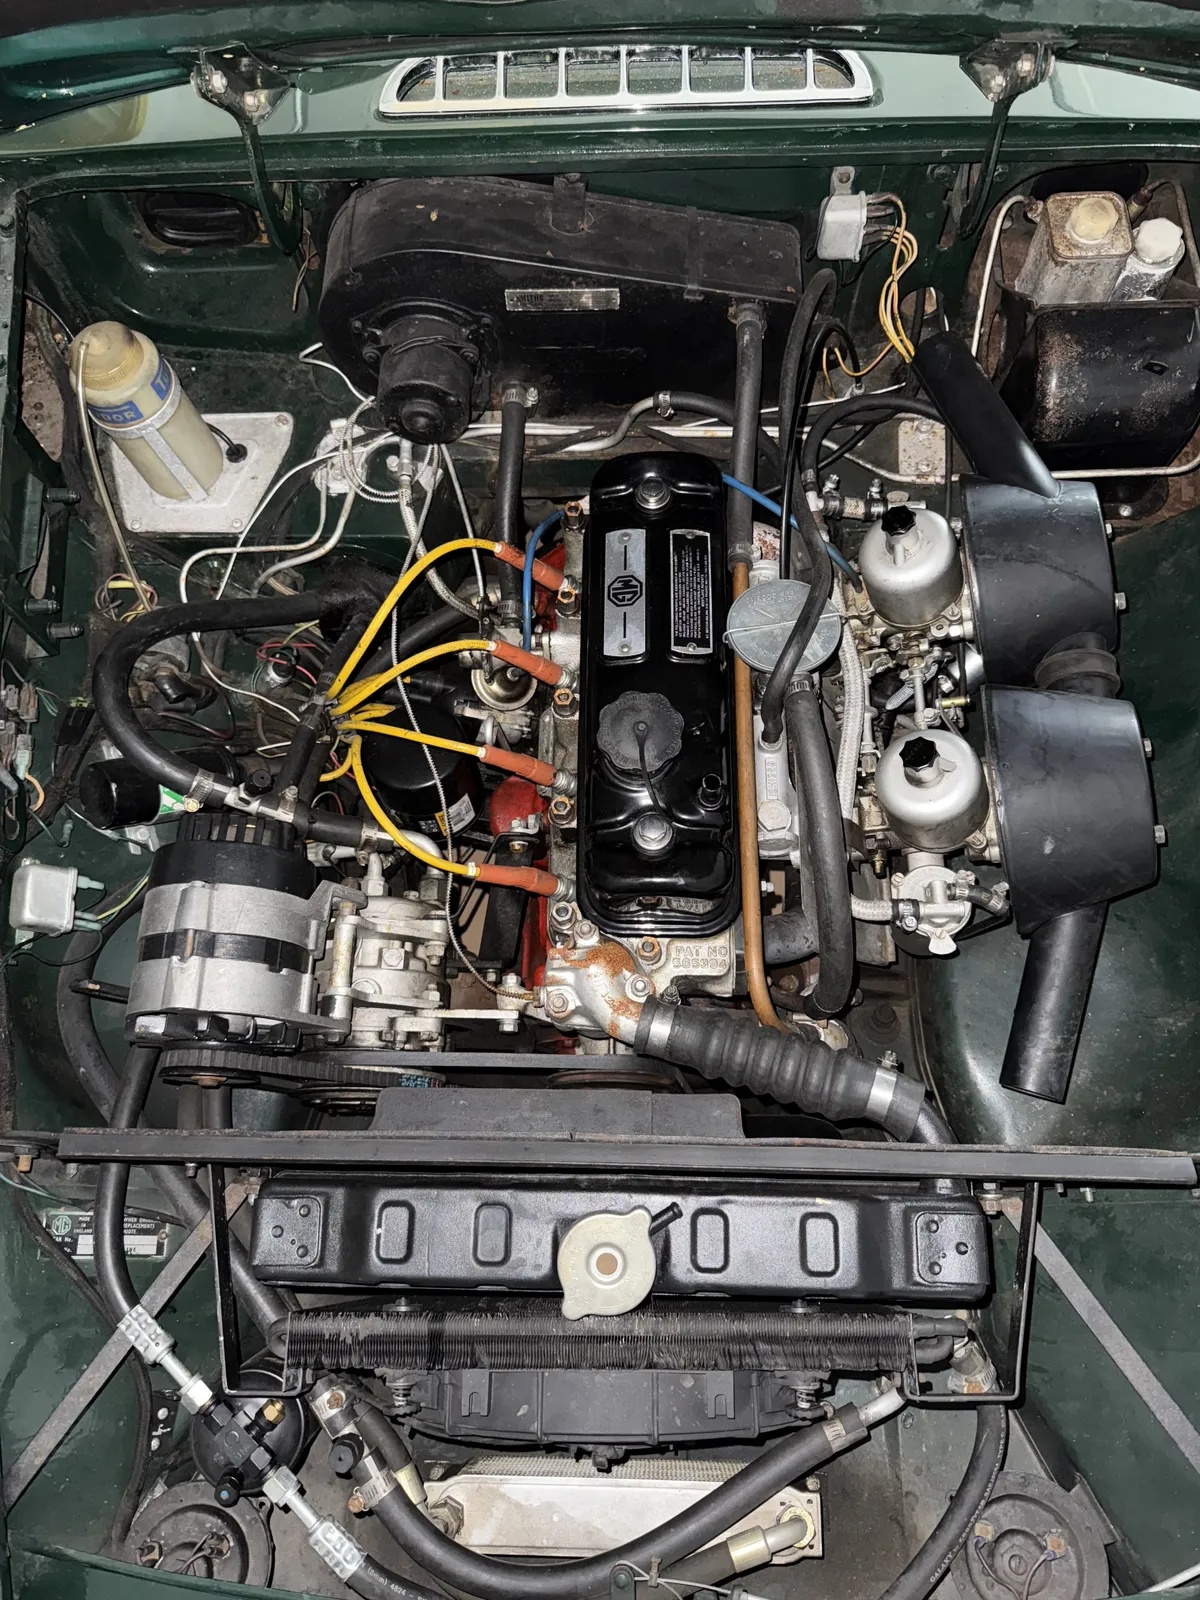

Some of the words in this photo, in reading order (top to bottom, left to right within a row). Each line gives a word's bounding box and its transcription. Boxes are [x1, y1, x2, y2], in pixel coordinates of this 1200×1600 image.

[611, 577, 640, 605] MG
[675, 945, 702, 957] PAT
[707, 946, 728, 958] NO
[672, 957, 728, 969] 565394
[53, 1216, 71, 1235] MG
[929, 1551, 953, 1583] GALAXY
[389, 1583, 407, 1597] 4824
